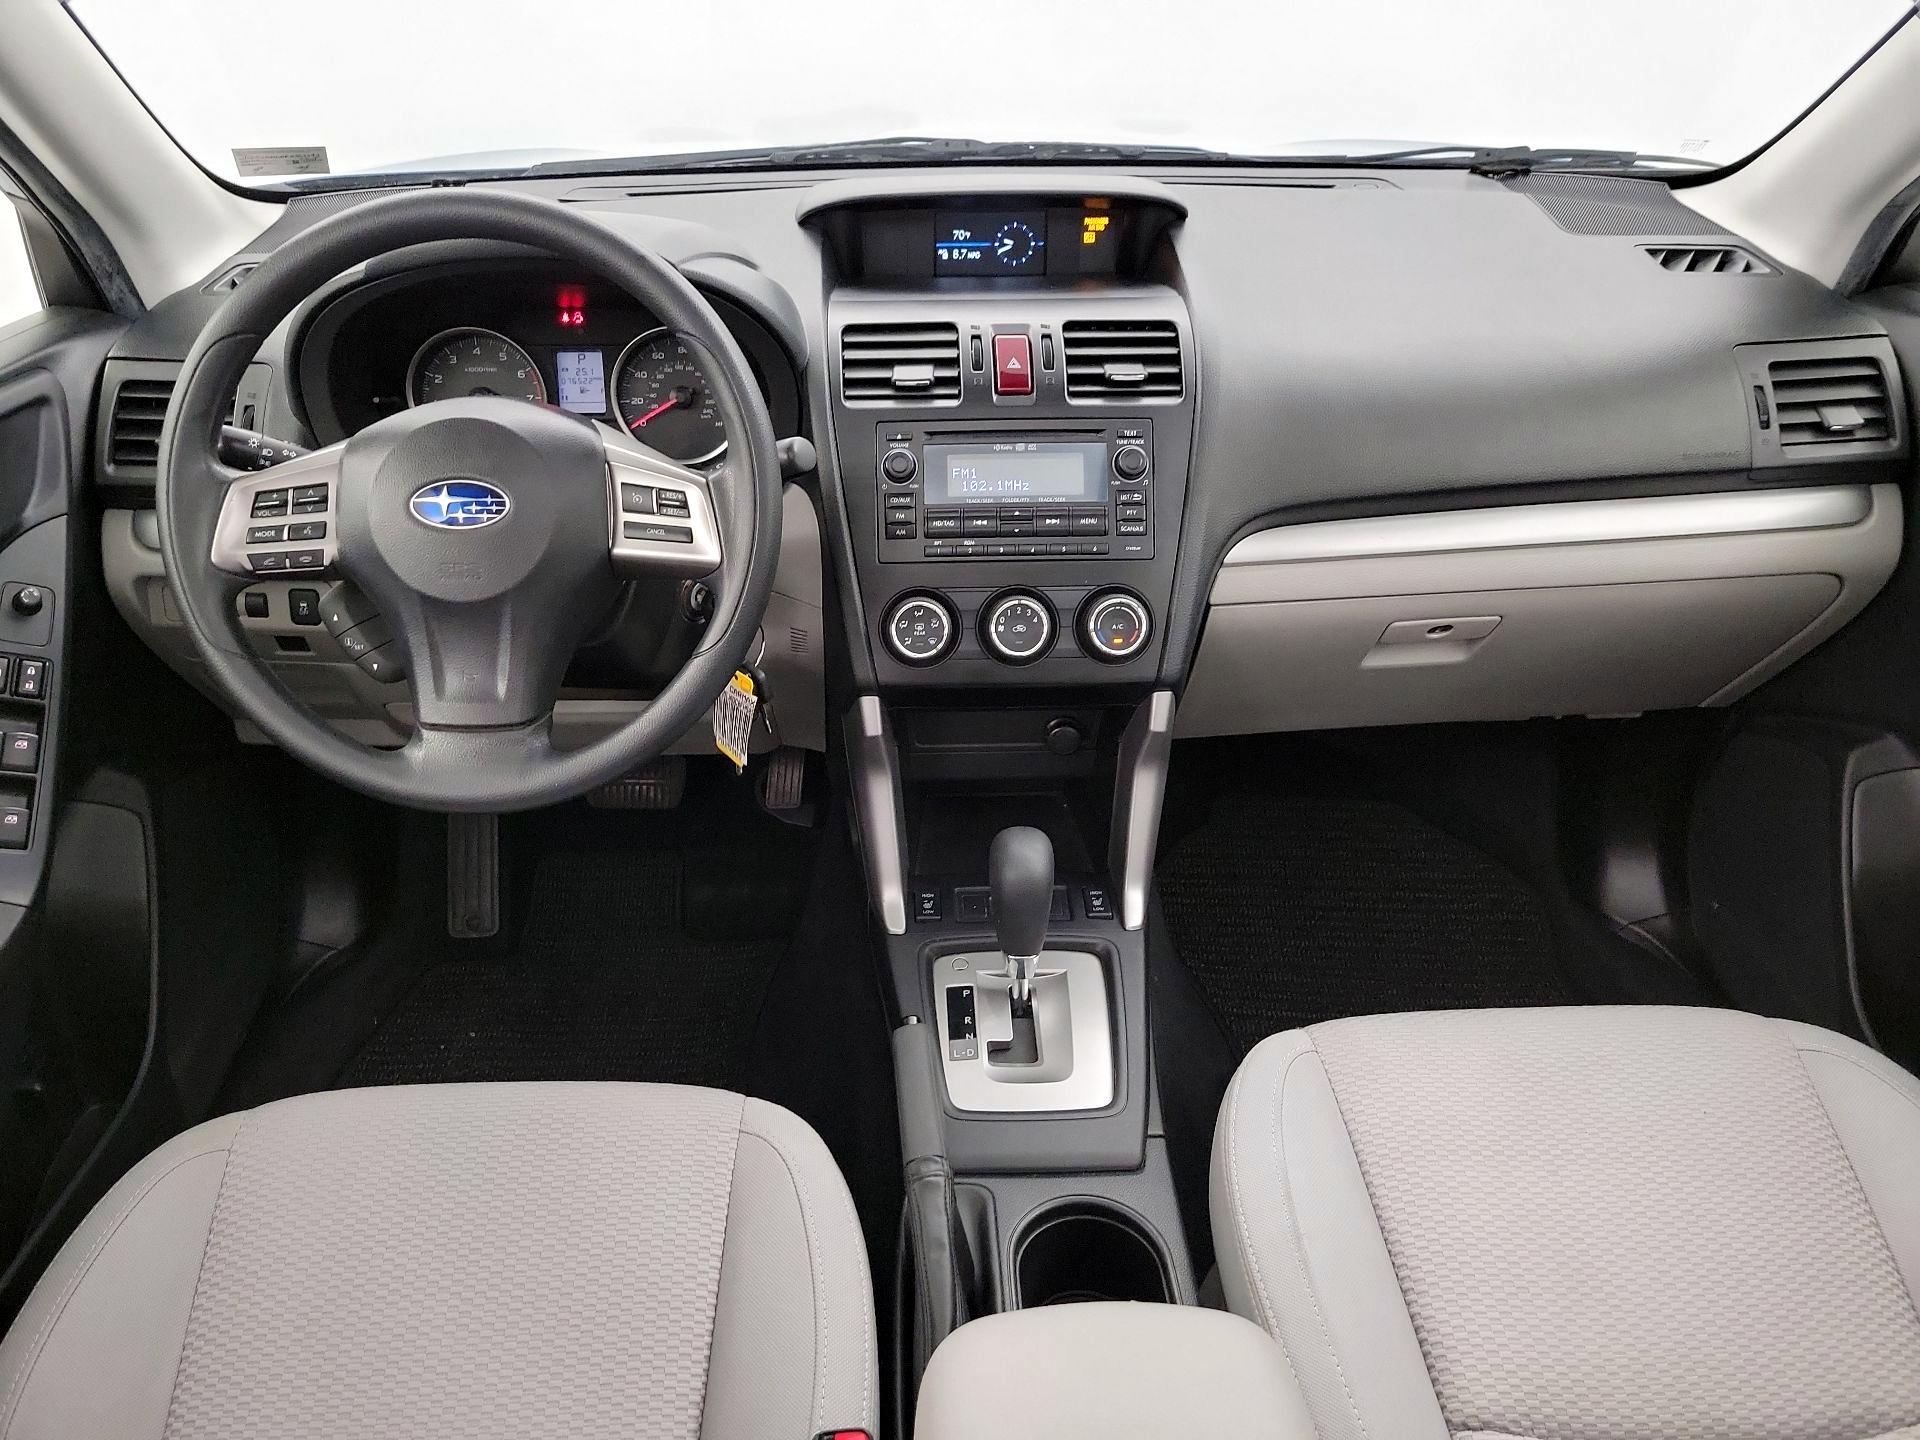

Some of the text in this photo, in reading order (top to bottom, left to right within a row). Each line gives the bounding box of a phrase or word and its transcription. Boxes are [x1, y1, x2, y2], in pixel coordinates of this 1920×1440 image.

[472, 346, 481, 355] 4
[449, 355, 457, 364] 3
[499, 352, 507, 361] 5
[577, 353, 586, 365] P
[651, 352, 665, 360] 60
[434, 374, 443, 384] 2
[517, 370, 526, 379] 6
[634, 371, 648, 379] 40
[630, 397, 644, 405] 20
[952, 467, 977, 479] FM1
[962, 480, 1030, 492] 102.1MHz
[1079, 517, 1098, 525] MENU
[254, 529, 276, 538] MODE
[646, 527, 666, 536] CANCEL
[1016, 606, 1022, 615] 2
[1026, 608, 1032, 617] 3
[1000, 616, 1006, 624] 0
[1032, 615, 1038, 623] 4
[962, 989, 971, 998] P
[963, 1016, 973, 1025] R
[965, 1032, 974, 1040] N
